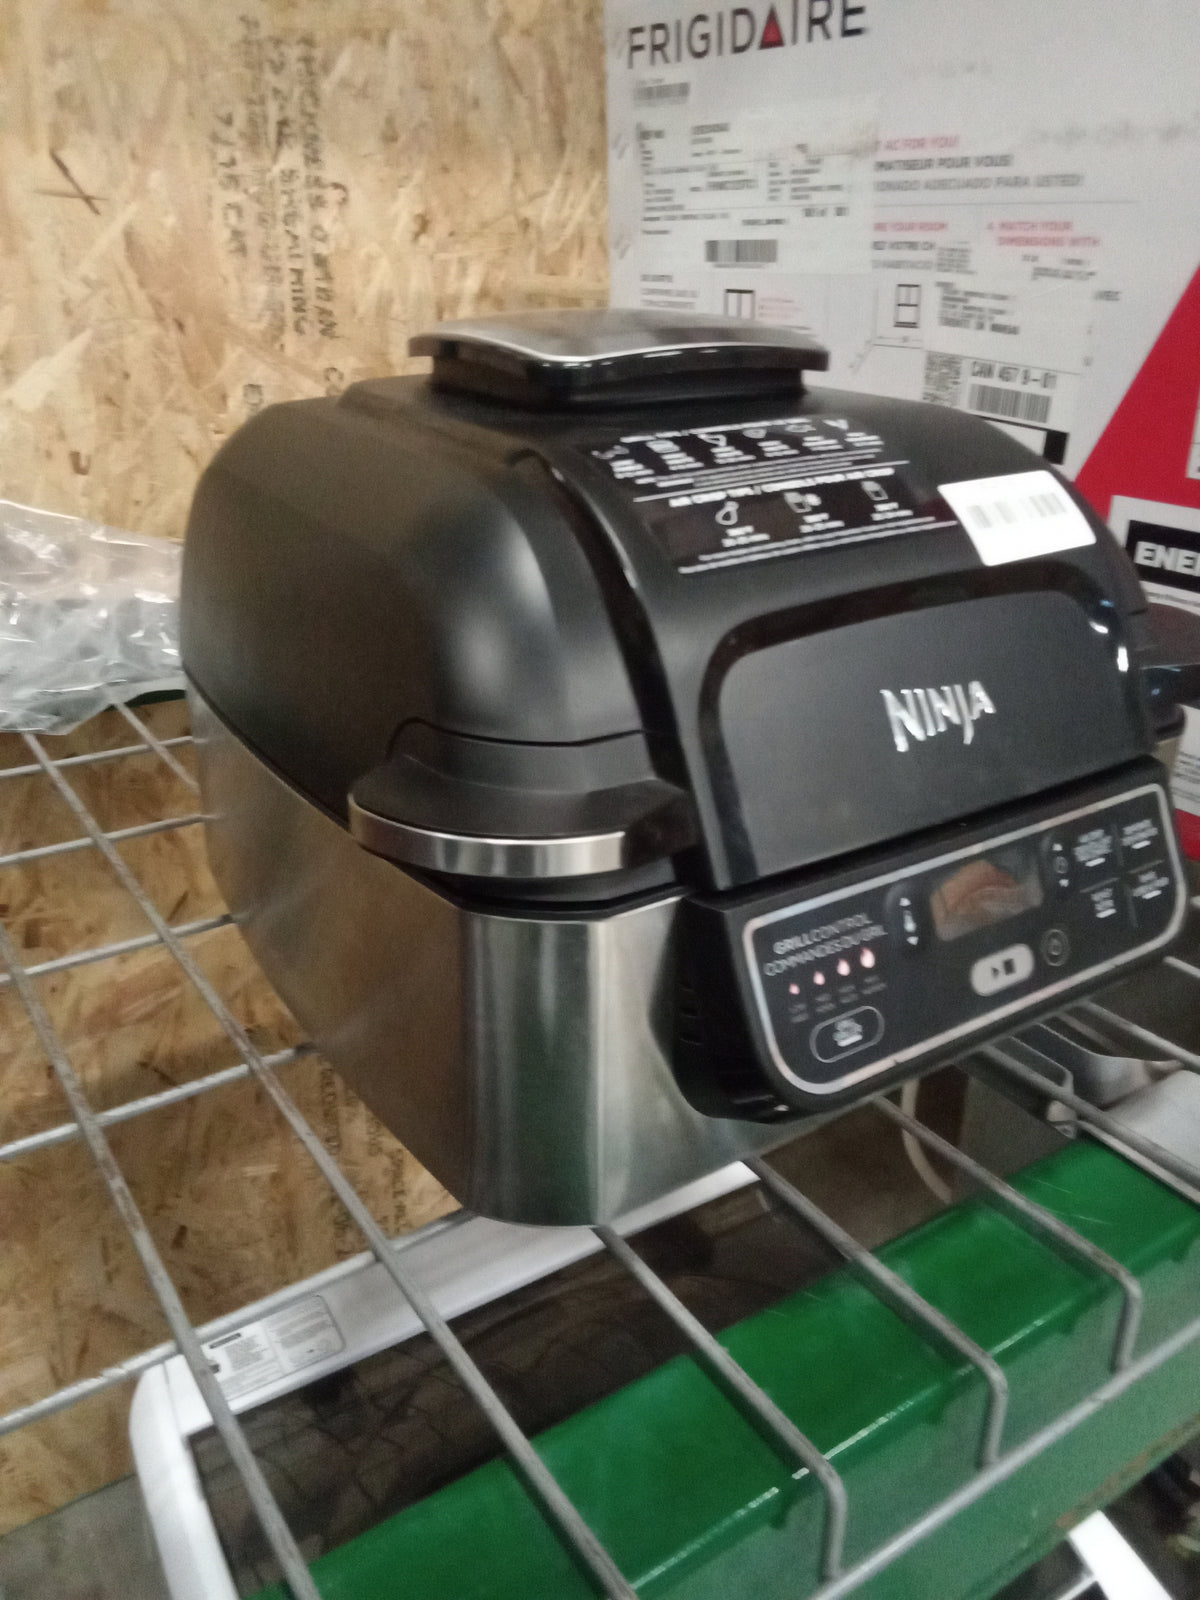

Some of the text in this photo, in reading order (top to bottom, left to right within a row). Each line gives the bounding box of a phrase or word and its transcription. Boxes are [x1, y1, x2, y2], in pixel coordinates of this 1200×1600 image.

[628, 0, 868, 68] FRIGIDAIRE
[1133, 541, 1200, 578] ENE
[879, 680, 997, 753] NINJA
